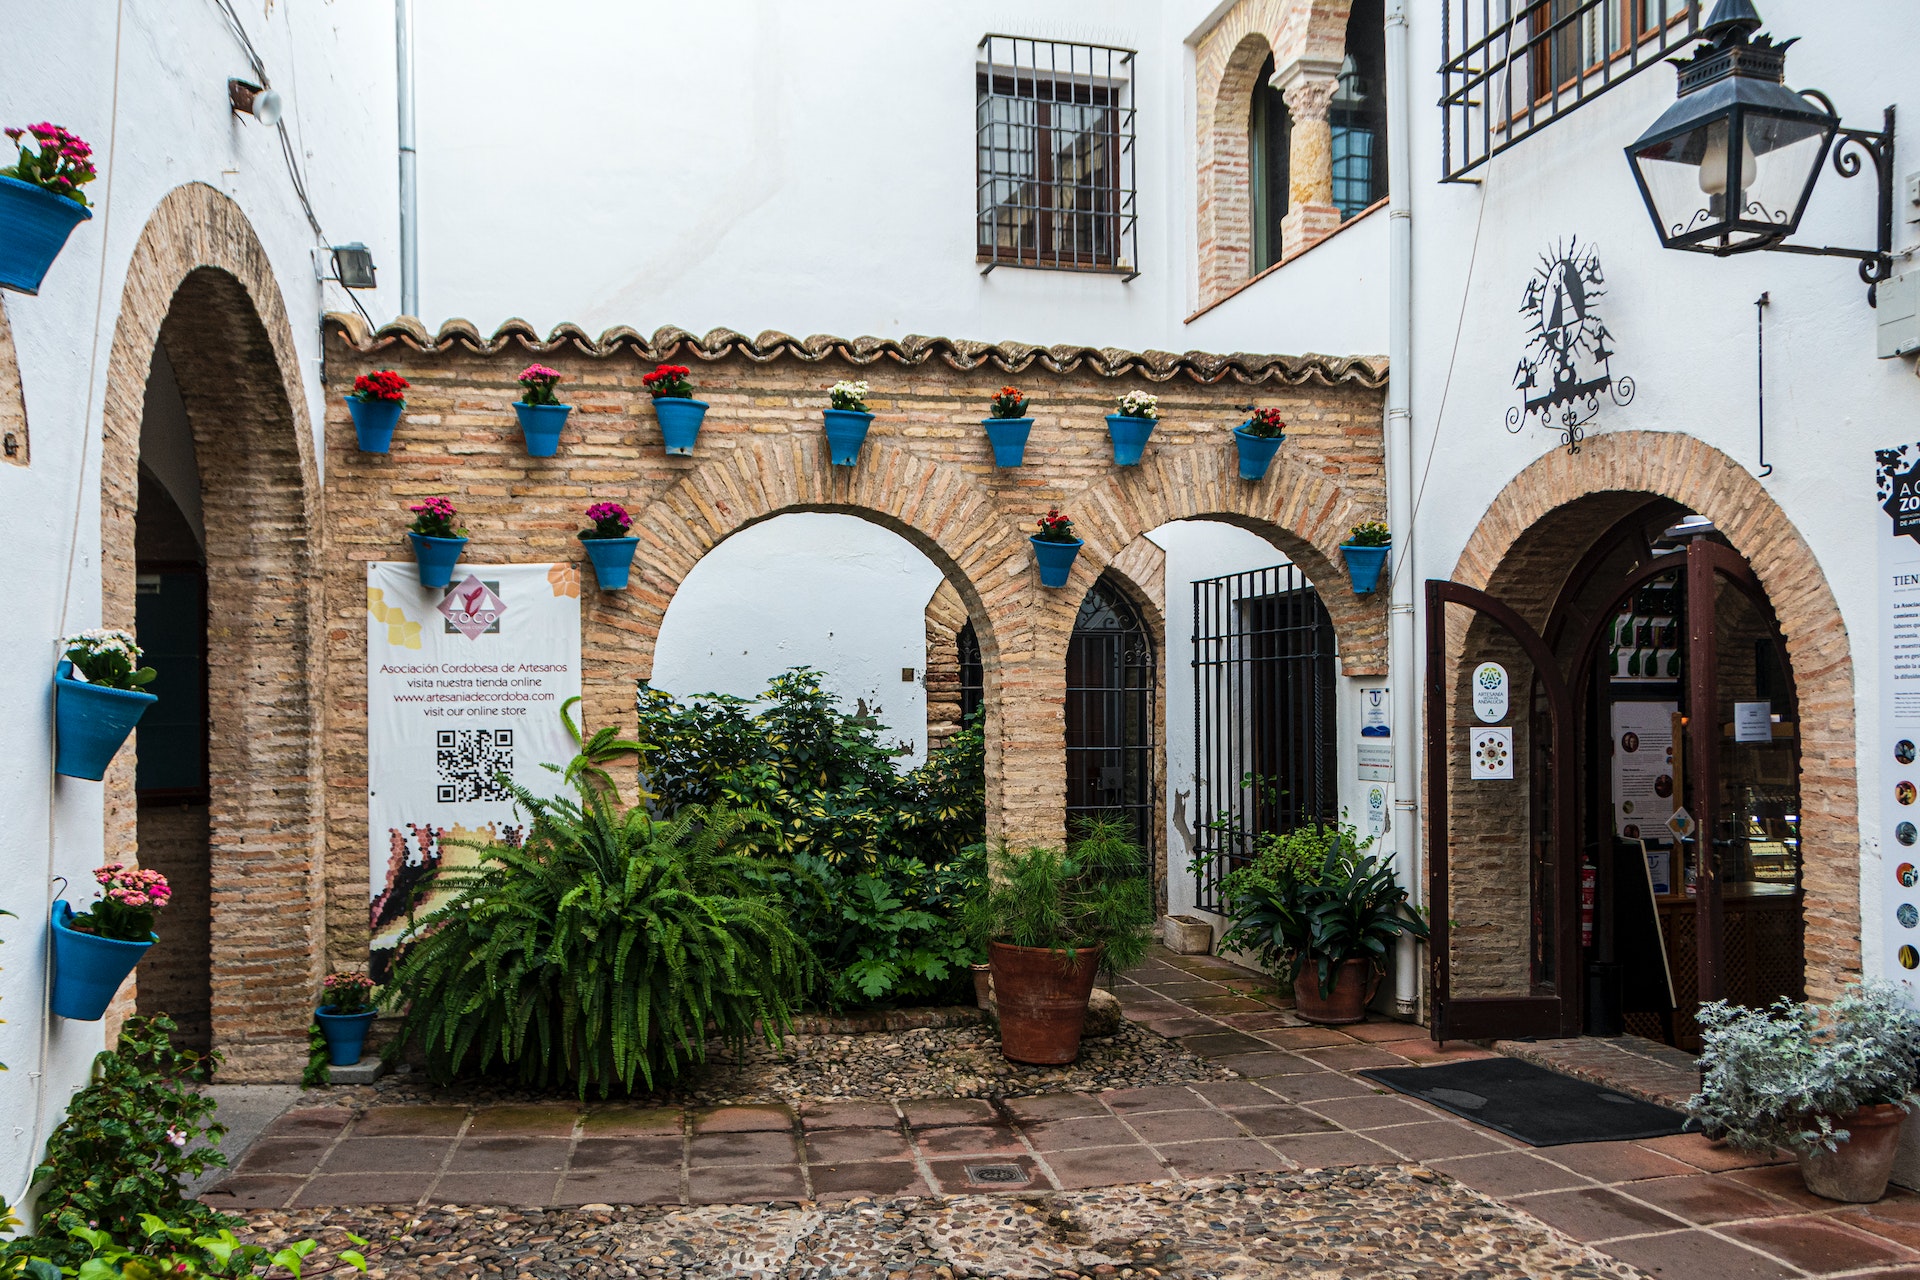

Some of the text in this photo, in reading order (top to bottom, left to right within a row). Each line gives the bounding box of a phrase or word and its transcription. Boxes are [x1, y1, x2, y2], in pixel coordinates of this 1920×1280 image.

[449, 612, 496, 624] ZOCO
[380, 663, 568, 674] Asociación Cordobesa de Artesanos
[407, 677, 542, 688] visita nuestra tienda online
[393, 691, 555, 702] www.artesaniadecordoba.com
[423, 706, 527, 717] visit our online store
